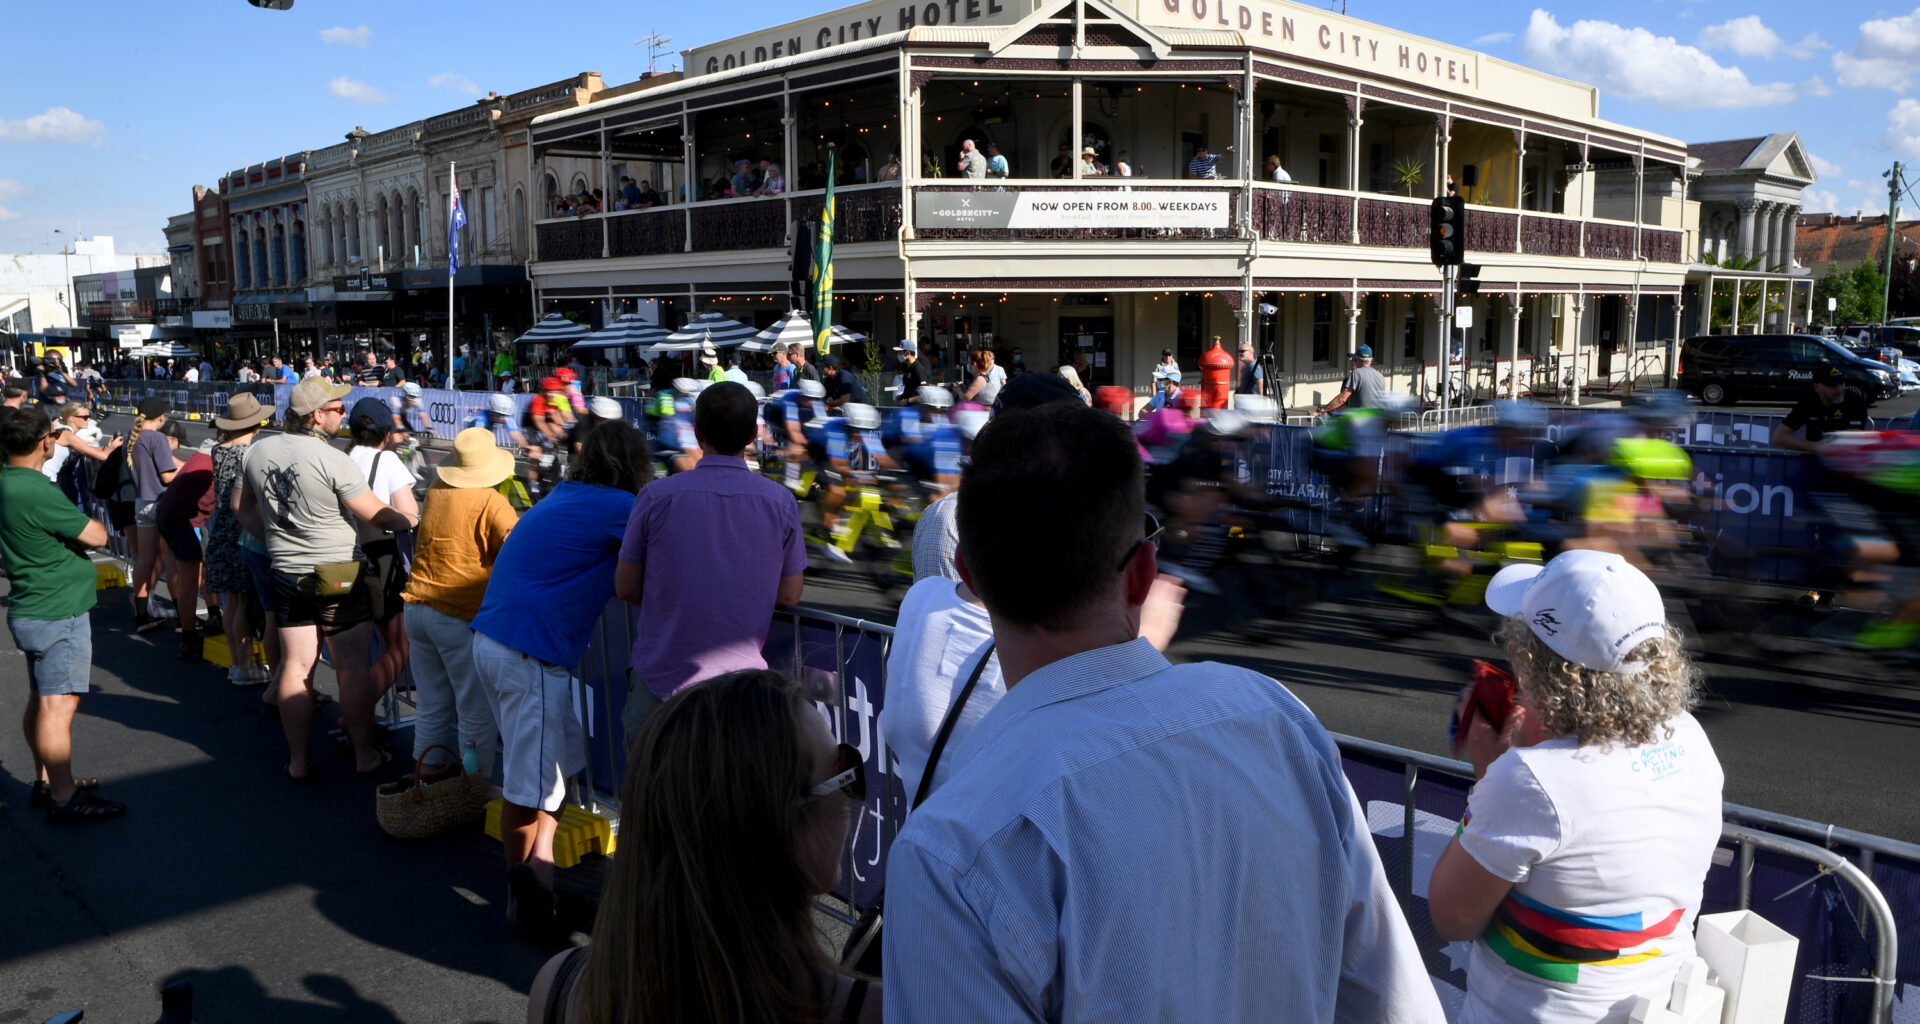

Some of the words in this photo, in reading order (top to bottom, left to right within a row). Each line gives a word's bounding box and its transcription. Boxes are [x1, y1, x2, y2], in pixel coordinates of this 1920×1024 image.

[706, 36, 802, 74] GOLDEN
[817, 16, 882, 50] CITY
[899, 0, 1003, 31] HOTEL
[1164, 0, 1295, 41] GOLDEN
[1318, 24, 1379, 62] CITY
[1398, 44, 1470, 84] HOTEL
[1031, 202, 1059, 211] NOW
[1062, 202, 1093, 211] OPEN
[1096, 202, 1129, 211] FROM
[1158, 202, 1218, 211] WEEKDAYS
